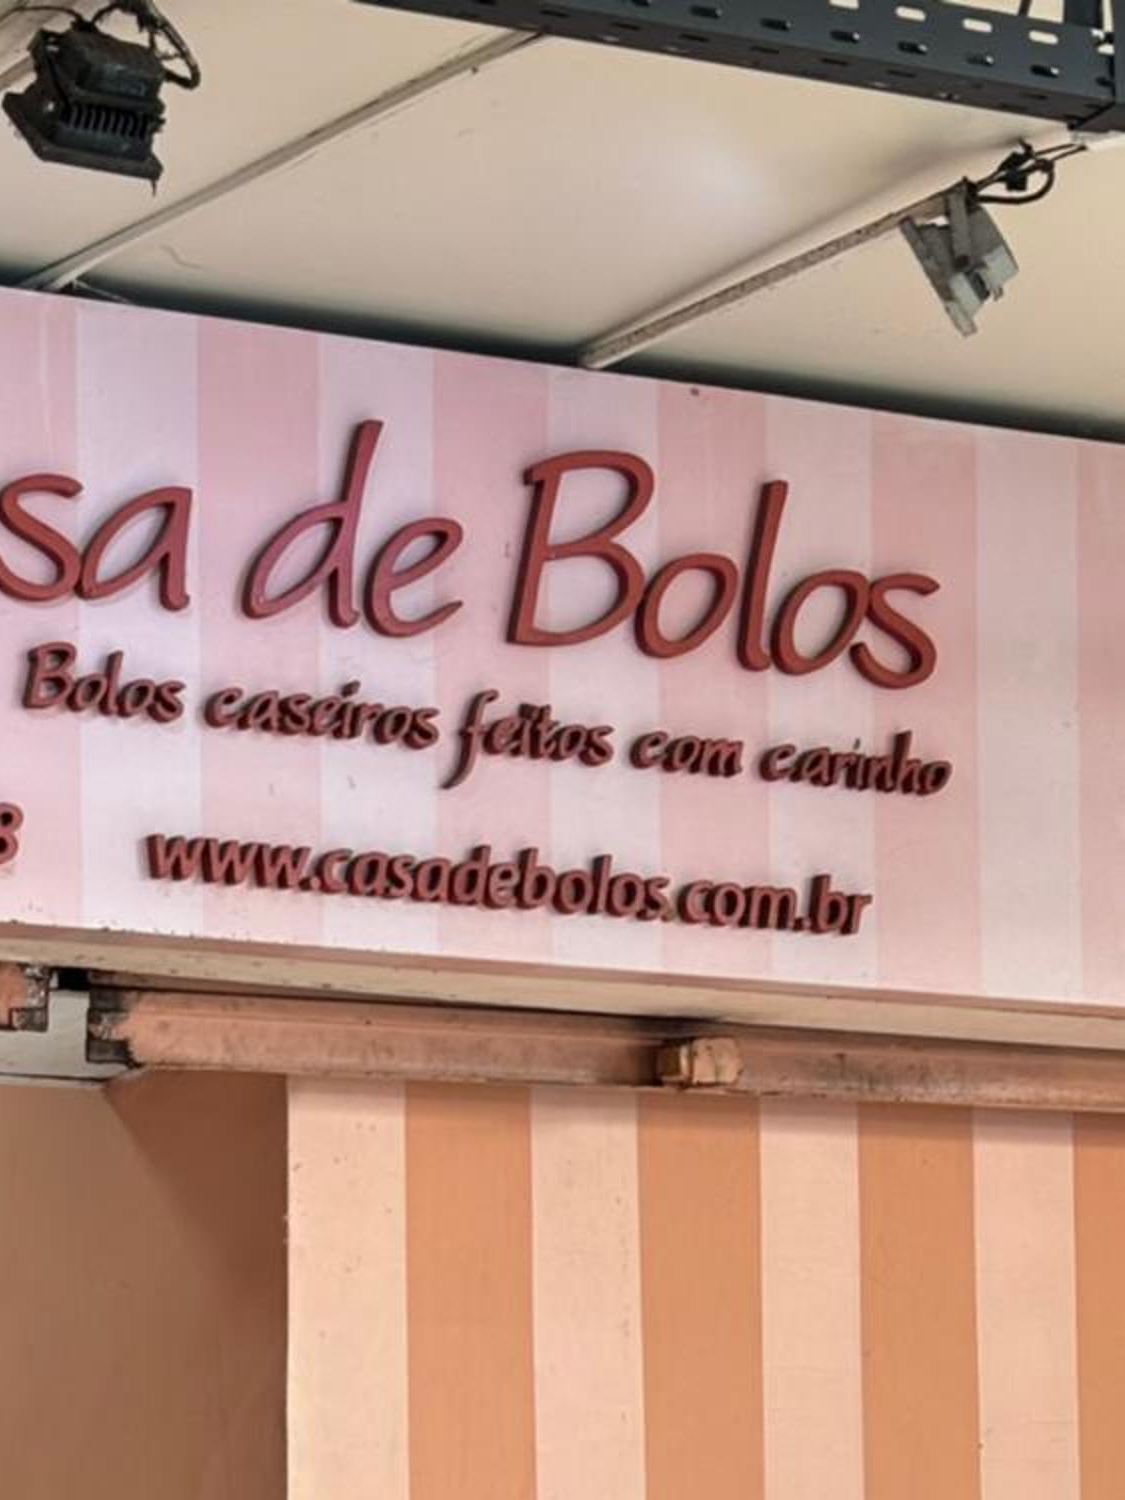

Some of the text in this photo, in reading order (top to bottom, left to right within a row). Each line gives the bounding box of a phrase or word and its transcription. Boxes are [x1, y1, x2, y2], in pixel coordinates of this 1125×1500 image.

[243, 419, 465, 640] de
[505, 450, 942, 690] Bolos
[23, 641, 952, 797] Bolos caseiros feitos com carinho
[145, 832, 873, 935] www.casadebolos.com.br
